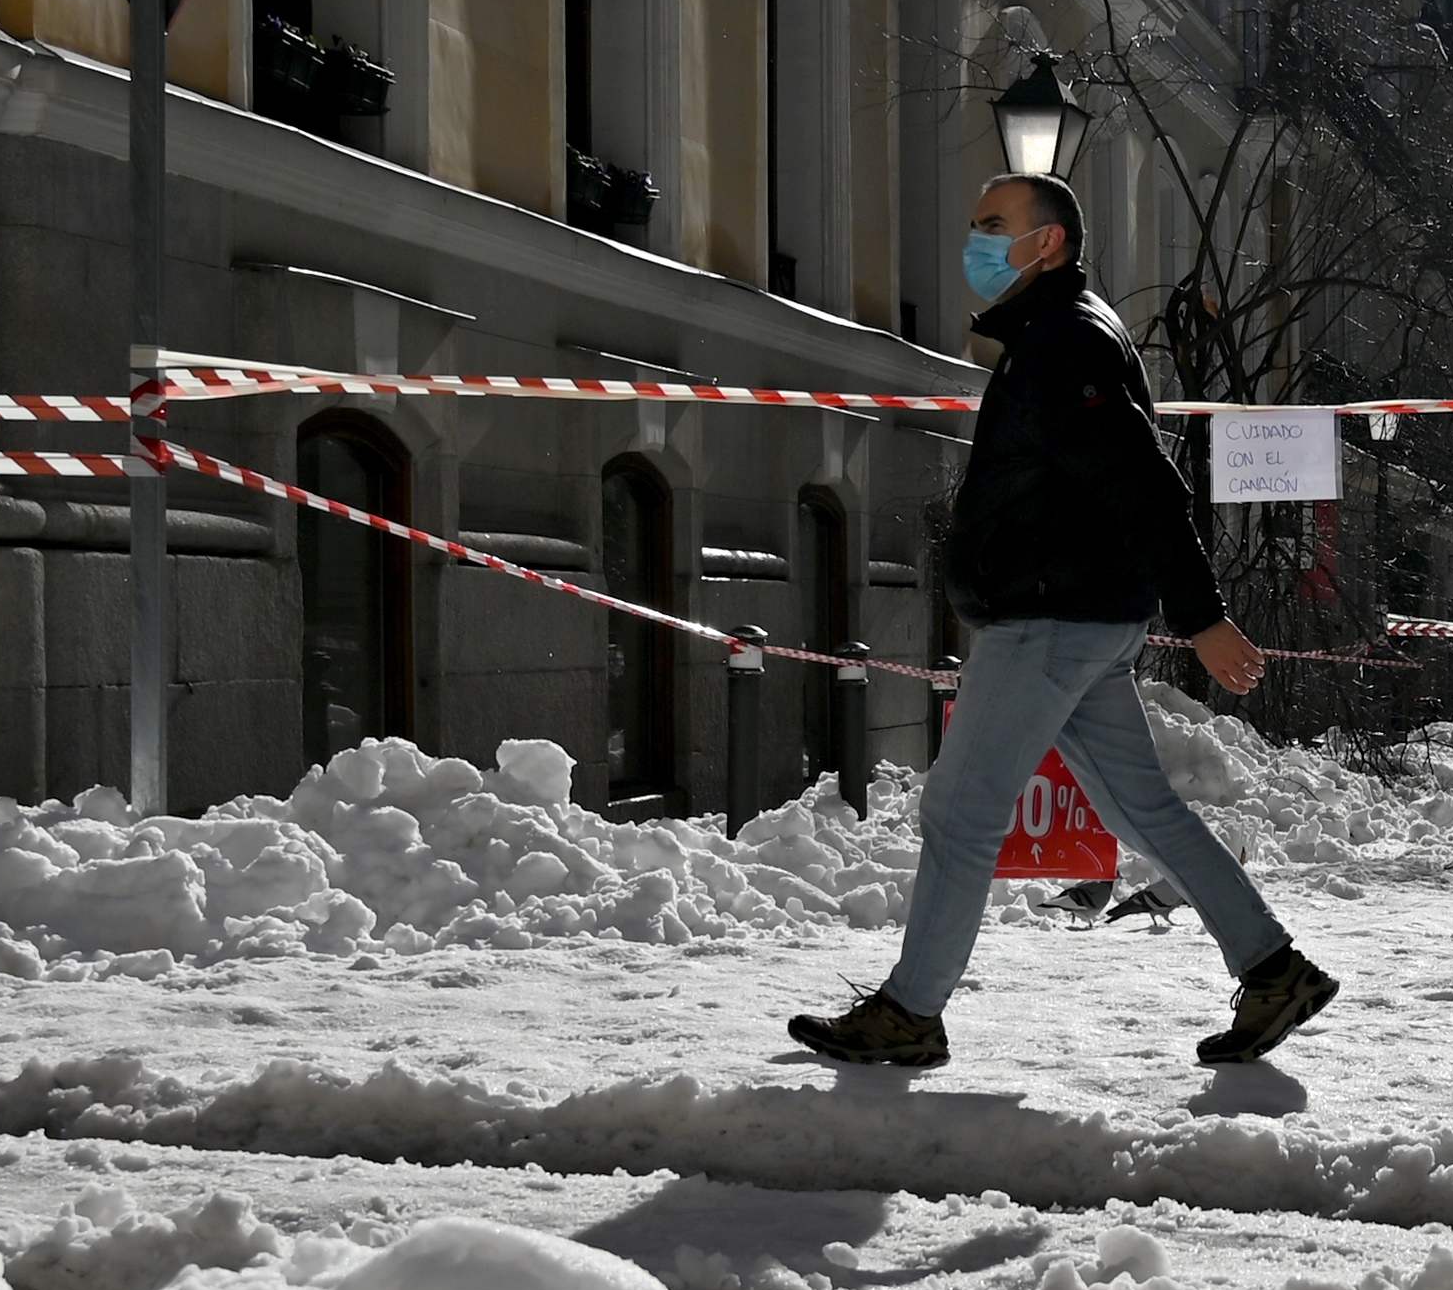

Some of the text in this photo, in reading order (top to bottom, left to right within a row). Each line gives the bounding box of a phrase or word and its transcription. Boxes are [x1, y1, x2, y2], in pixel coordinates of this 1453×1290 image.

[1225, 421, 1304, 441] CUIDADO
[1227, 450, 1286, 469] CON EL
[1228, 470, 1299, 495] CANALÓN
[1005, 774, 1088, 839] 0%
